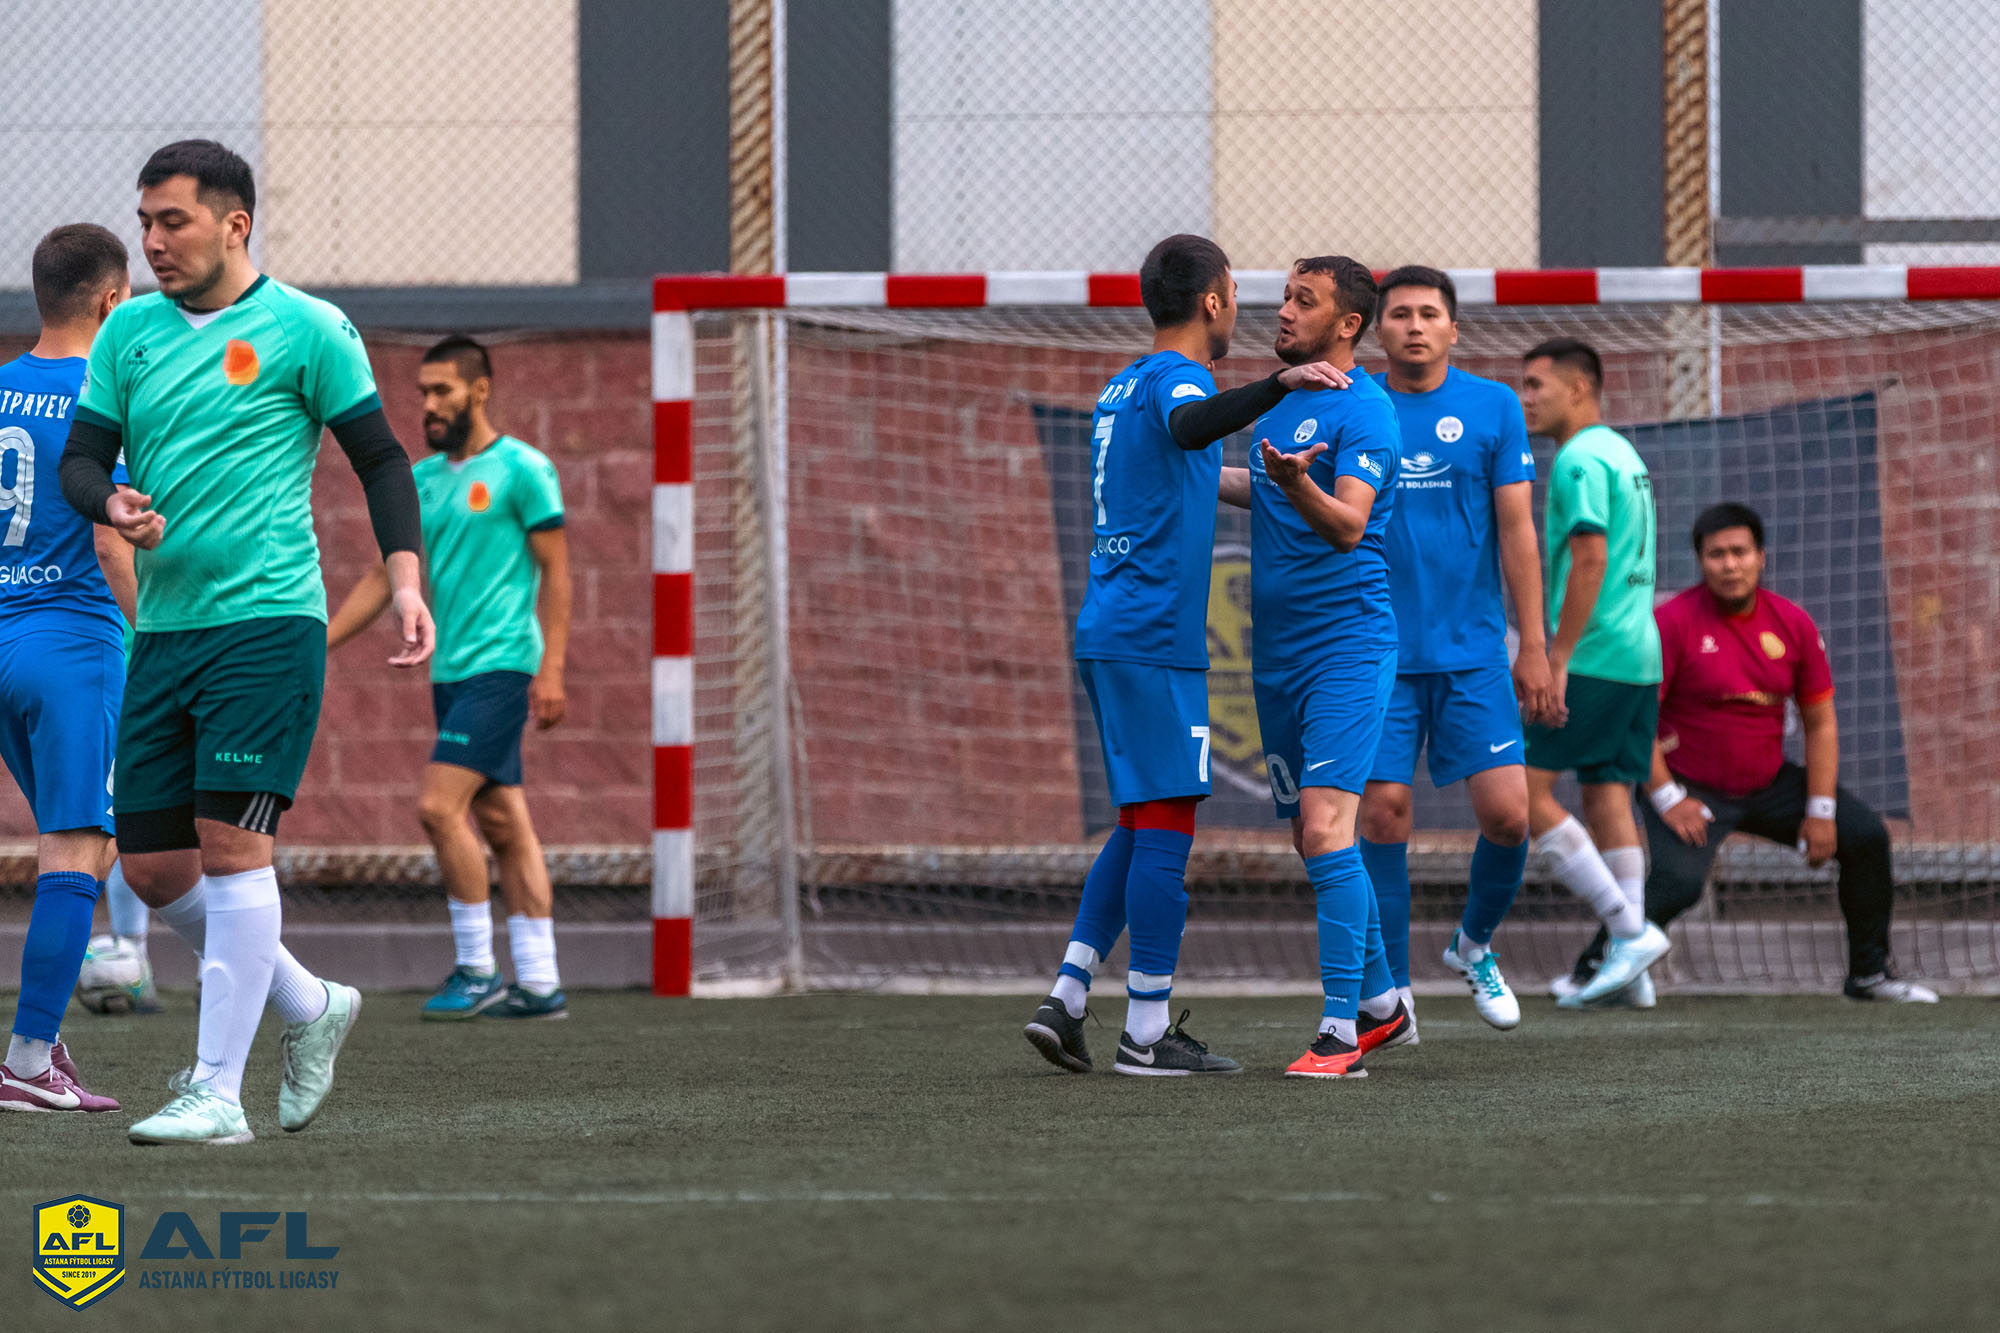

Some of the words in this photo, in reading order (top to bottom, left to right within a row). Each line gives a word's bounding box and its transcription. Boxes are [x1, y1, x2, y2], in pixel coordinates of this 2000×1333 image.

[0, 389, 72, 419] TPAYEV
[0, 426, 35, 547] 9
[1094, 413, 1116, 526] 7
[215, 752, 263, 764] KELME
[1190, 726, 1210, 783] 7
